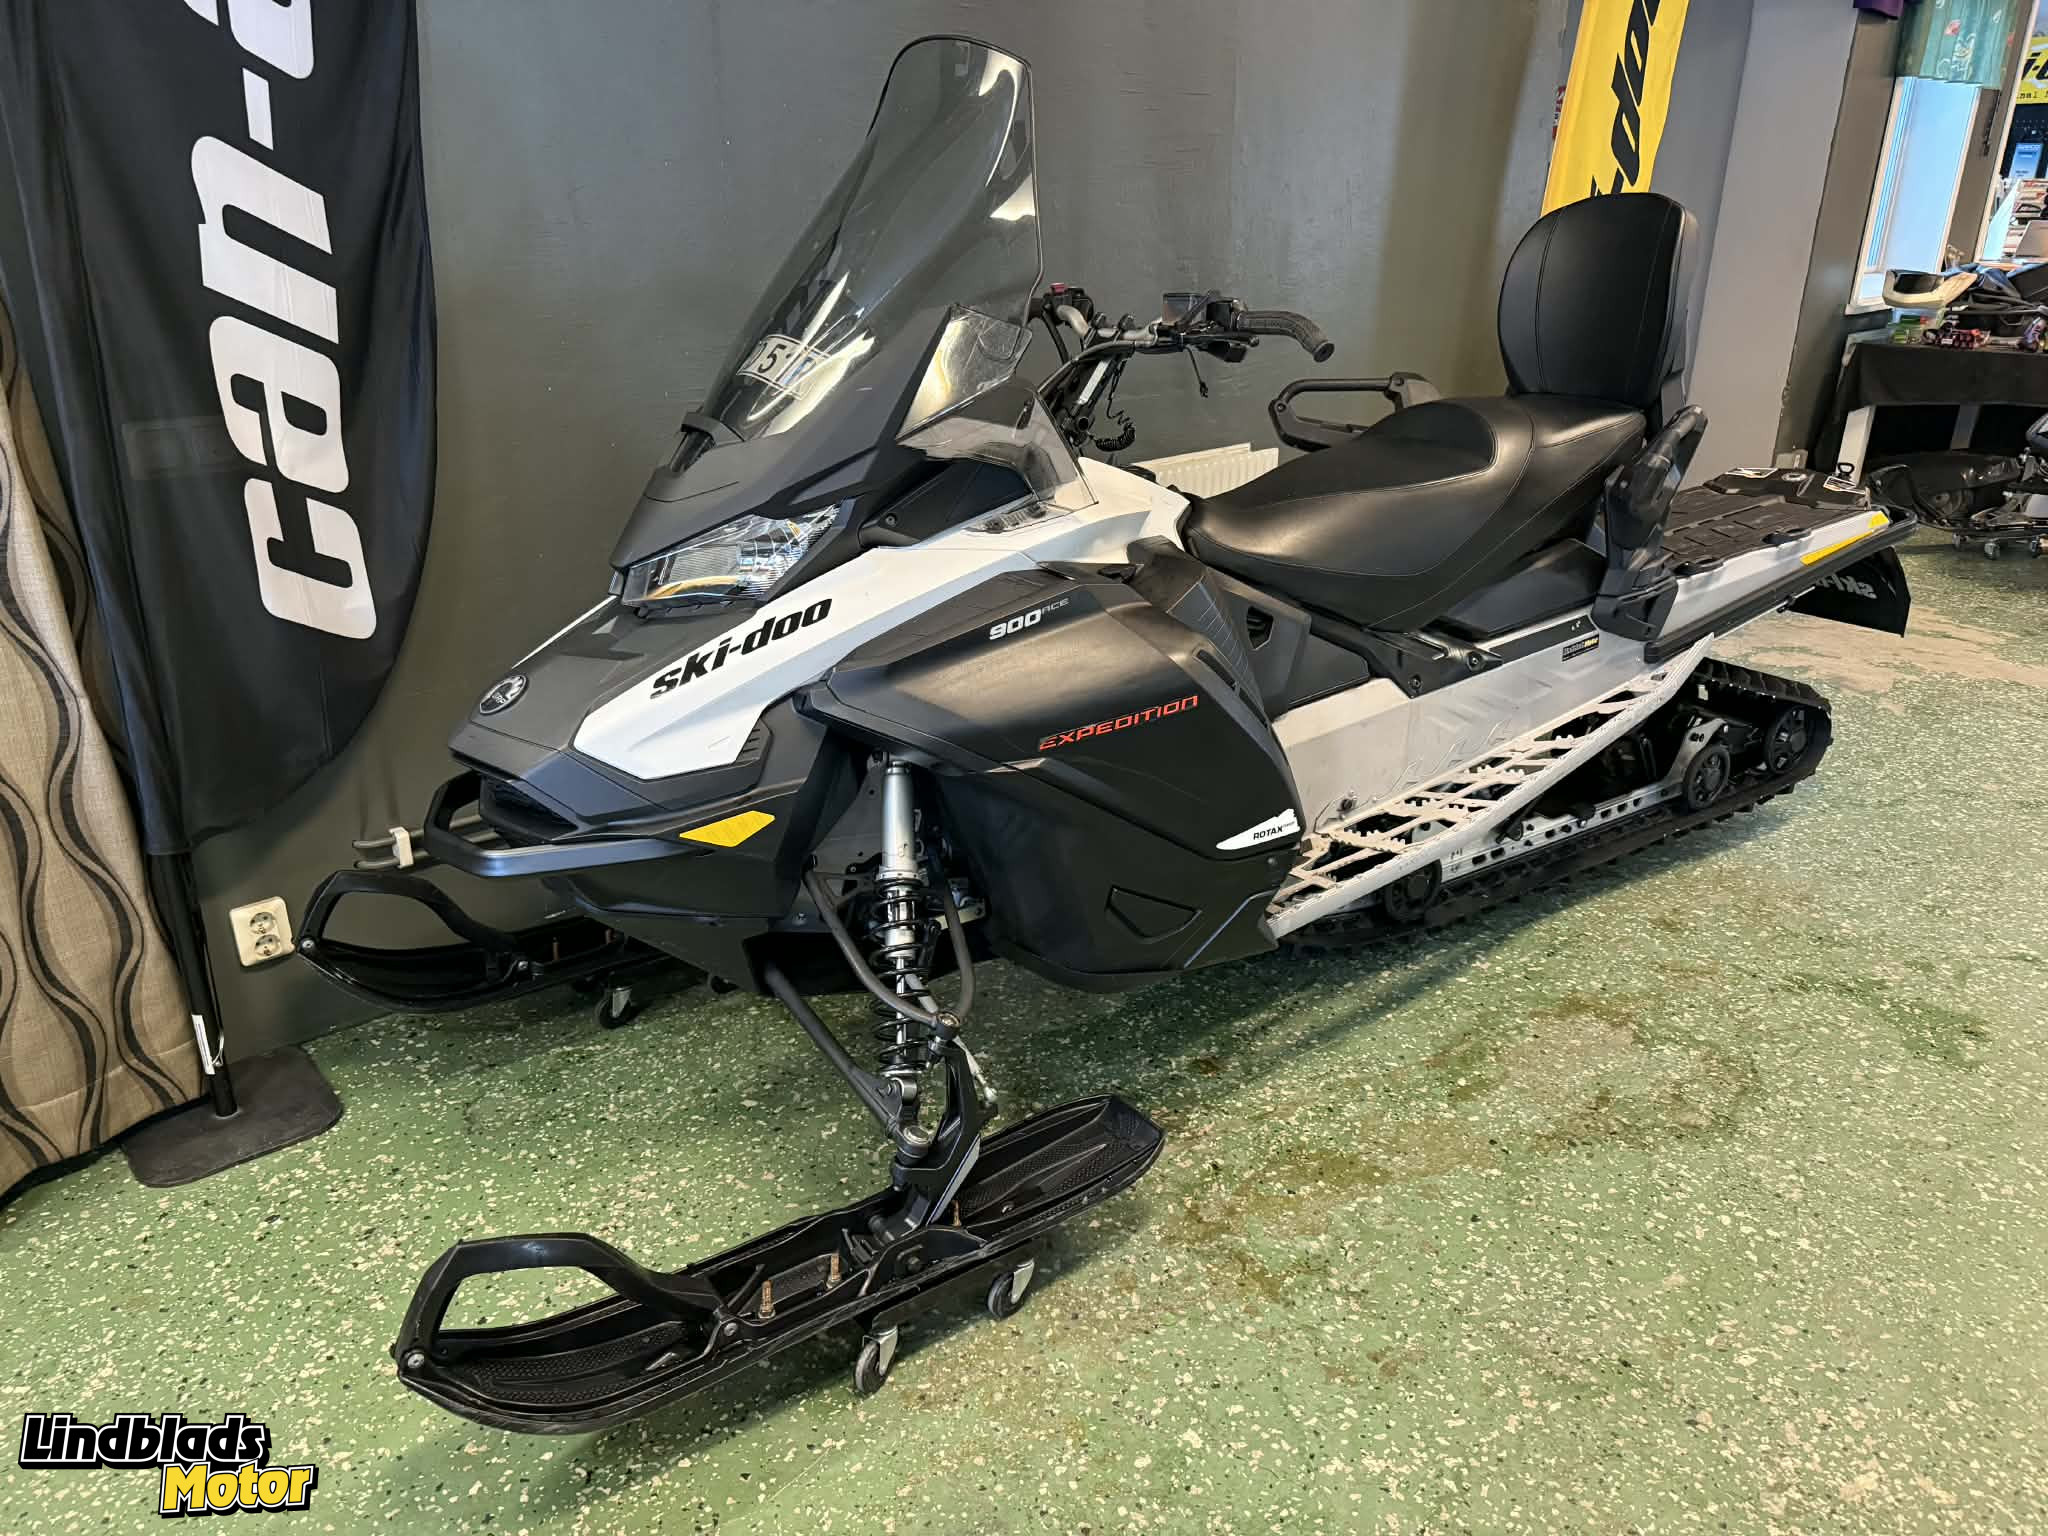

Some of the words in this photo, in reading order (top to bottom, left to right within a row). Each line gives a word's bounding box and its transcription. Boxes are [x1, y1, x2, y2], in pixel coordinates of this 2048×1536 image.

[989, 609, 1042, 640] 900
[650, 598, 833, 699] ski-doo
[1039, 695, 1199, 751] EXPEDITION
[1253, 825, 1283, 841] ROTAX
